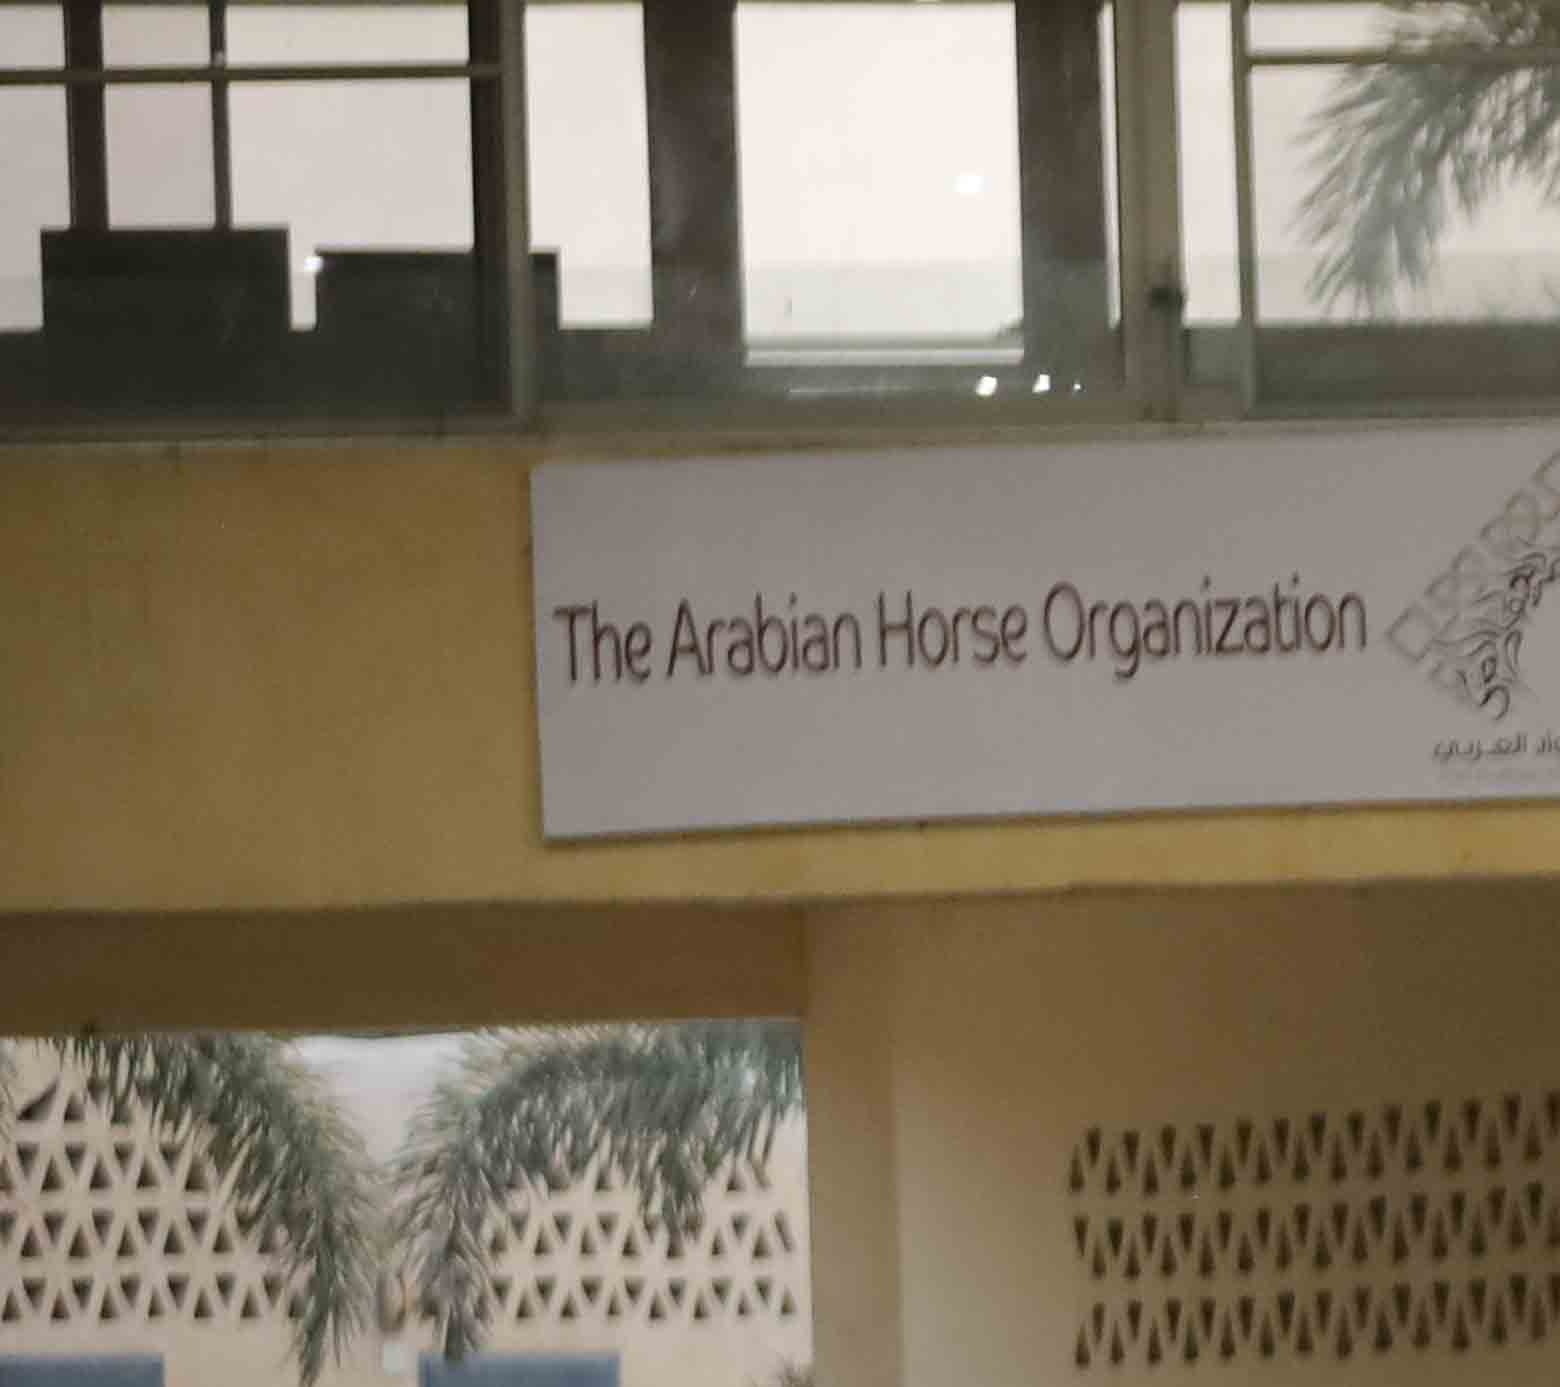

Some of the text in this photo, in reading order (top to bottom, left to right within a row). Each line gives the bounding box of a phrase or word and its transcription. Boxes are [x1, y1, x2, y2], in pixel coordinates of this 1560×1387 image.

[551, 572, 1368, 685] The Arabian Horse Organization
